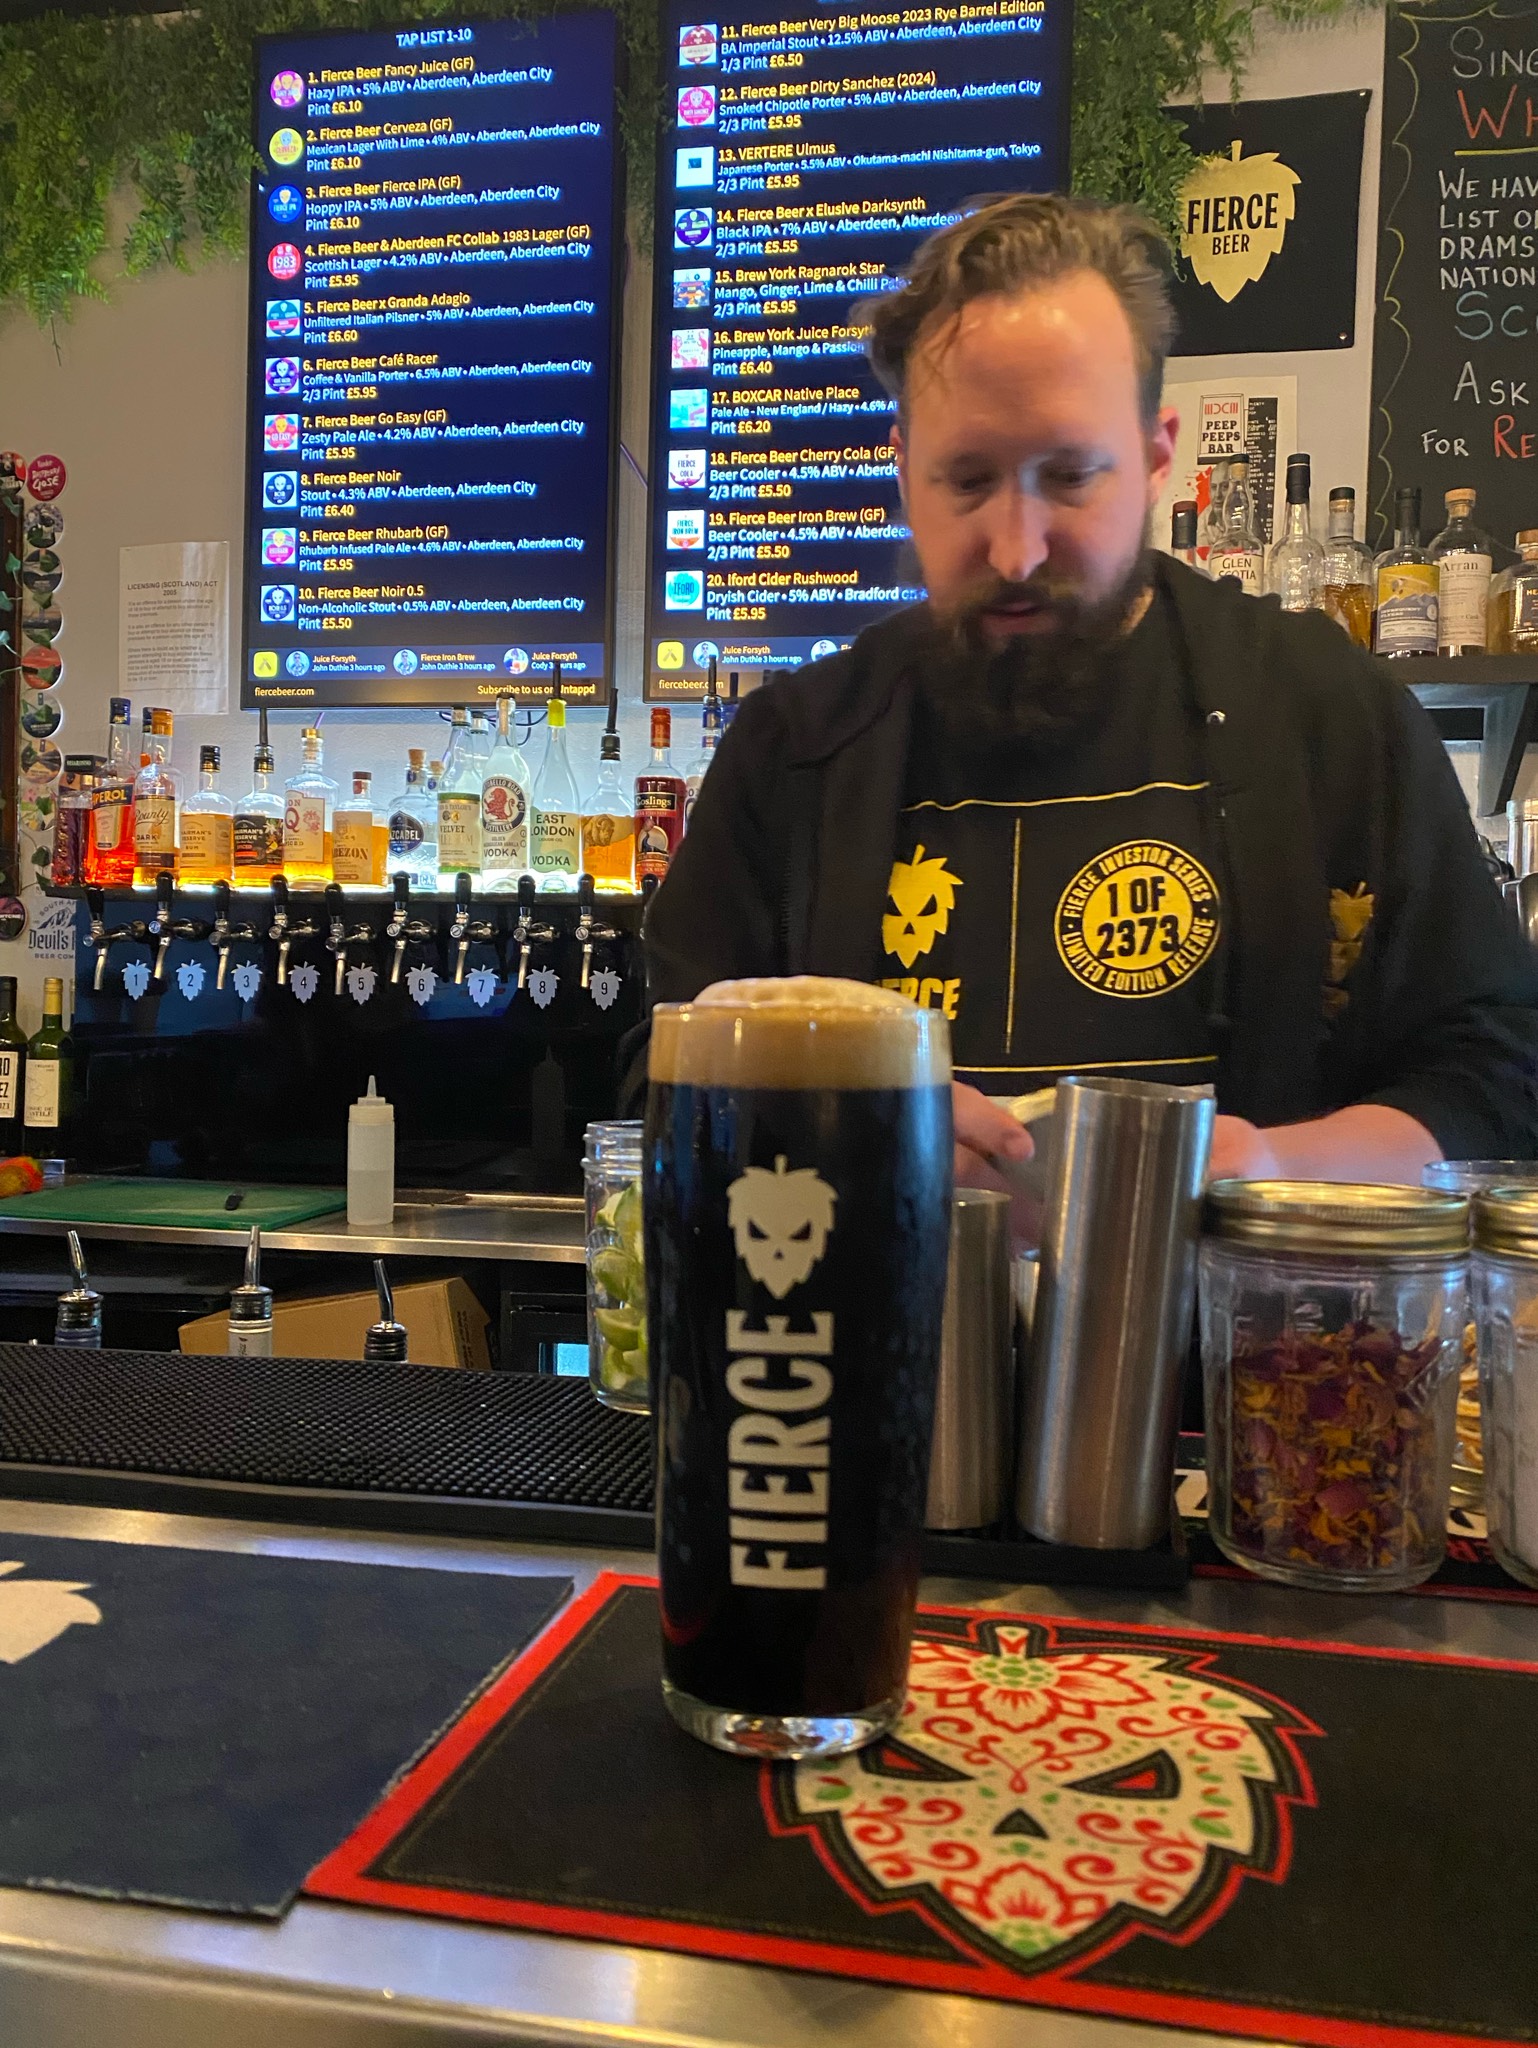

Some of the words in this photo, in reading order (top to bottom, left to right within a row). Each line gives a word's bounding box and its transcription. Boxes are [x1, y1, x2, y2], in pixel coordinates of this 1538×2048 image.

[721, 25, 739, 39] 11.
[741, 23, 777, 37] Fierce
[779, 20, 808, 34] Beer
[808, 18, 836, 32] Very
[838, 15, 858, 30] Big
[860, 13, 900, 26] Moose
[902, 8, 931, 25] 2023
[934, 7, 957, 22] Rye
[959, 1, 997, 22] Barrel
[999, 0, 1044, 18] Edition
[395, 32, 418, 46] TAP
[420, 30, 445, 44] LIST
[446, 27, 471, 42] 1-10
[308, 71, 318, 84] 1.
[321, 69, 354, 82] Fierce
[356, 67, 382, 79] Beer
[384, 64, 417, 77] Fancy
[418, 60, 449, 73] Juice
[450, 56, 474, 72] (GF)
[307, 88, 335, 100] Hazy
[336, 84, 355, 96] IPA
[362, 82, 381, 95] 5%
[382, 79, 405, 93] ABV
[412, 75, 470, 90] Aberdeen,
[471, 70, 527, 84] Aberdeen
[529, 67, 552, 81] City
[307, 103, 330, 116] Pint
[331, 100, 362, 114] £6.10
[717, 158, 763, 176] Japanese
[764, 156, 794, 172] Porter
[800, 158, 825, 170] 5.5%
[825, 156, 846, 167] ABV
[852, 150, 931, 165] Okutama-machi
[932, 147, 1008, 159] Nishitama-gun,
[1009, 143, 1040, 156] Tokyo
[718, 148, 736, 162] 13.
[737, 144, 793, 160] VERTERE
[795, 142, 835, 156] Ulmus
[717, 178, 737, 193] 2/3
[739, 177, 764, 190] Pint
[766, 174, 800, 189] £5.95
[1439, 168, 1479, 199] WE
[1188, 193, 1278, 234] FIERCE
[1440, 205, 1499, 228] LIST
[1212, 234, 1249, 255] BEER
[1440, 235, 1535, 260] DRAMS
[1455, 290, 1538, 340] SC
[302, 359, 313, 371] 6.
[316, 358, 349, 370] Fierce
[350, 356, 377, 369] Beer
[378, 353, 404, 367] Café
[406, 353, 438, 365] Racer
[1453, 361, 1529, 406] ASK
[302, 388, 320, 402] 2/3
[322, 387, 345, 399] Pint
[346, 386, 377, 399] £5.95
[711, 391, 729, 404] 17.
[732, 388, 782, 403] BOXCAR
[784, 387, 823, 400] Native
[825, 386, 859, 399] Place
[711, 421, 736, 434] Pint
[737, 420, 771, 434] £6.20
[1206, 421, 1237, 431] PEEP
[1202, 431, 1240, 442] PEEPS
[1421, 429, 1470, 457] FOR
[1208, 443, 1234, 454] BAR
[300, 473, 311, 485] 8.
[313, 472, 347, 485] Fierce
[348, 471, 375, 484] Beer
[377, 469, 401, 482] Noir
[300, 489, 330, 501] Stout
[337, 487, 366, 499] 4.3%
[366, 486, 390, 498] ABV
[397, 484, 455, 497] Aberdeen,
[455, 482, 511, 494] Aberdeen
[512, 480, 536, 495] City
[300, 505, 322, 517] Pint
[324, 504, 354, 517] £6.40
[1222, 558, 1252, 569] GLEN
[161, 581, 202, 589] (SCOTLAND)
[706, 574, 725, 587] 20.
[727, 572, 756, 586] Iford
[758, 572, 791, 586] Cider
[793, 570, 857, 584] Rushwood
[706, 589, 745, 605] Dryish
[746, 589, 780, 603] Cider
[788, 588, 809, 602] 5%
[809, 588, 836, 601] ABV
[845, 587, 899, 600] Bradford
[420, 653, 441, 663] Fierce
[441, 653, 456, 663] Iron
[457, 653, 475, 663] Brew
[254, 687, 314, 696] fiercebeer.com
[521, 686, 530, 694] to
[284, 807, 300, 833] Q
[536, 814, 566, 824] EAST
[484, 849, 517, 857] VODKA
[532, 856, 570, 866] VODKA
[1099, 846, 1172, 876] INVESTOR
[1168, 856, 1213, 903] SERIES
[1063, 871, 1101, 919] FIERCE
[1107, 883, 1119, 917] 1
[1130, 876, 1167, 914] OF
[1097, 915, 1181, 960] 2373
[1166, 917, 1215, 977] RELEASE
[1062, 931, 1106, 983] LIMITED
[134, 974, 138, 986] 1
[187, 974, 194, 987] 2
[243, 975, 250, 988] 3
[300, 976, 307, 989] 4
[358, 978, 364, 990] 5
[418, 978, 425, 991] 6
[478, 979, 485, 992] 7
[539, 980, 546, 993] 8
[601, 981, 608, 995] 9
[1103, 966, 1168, 992] EDITION
[726, 1309, 834, 1590] FIERCE
